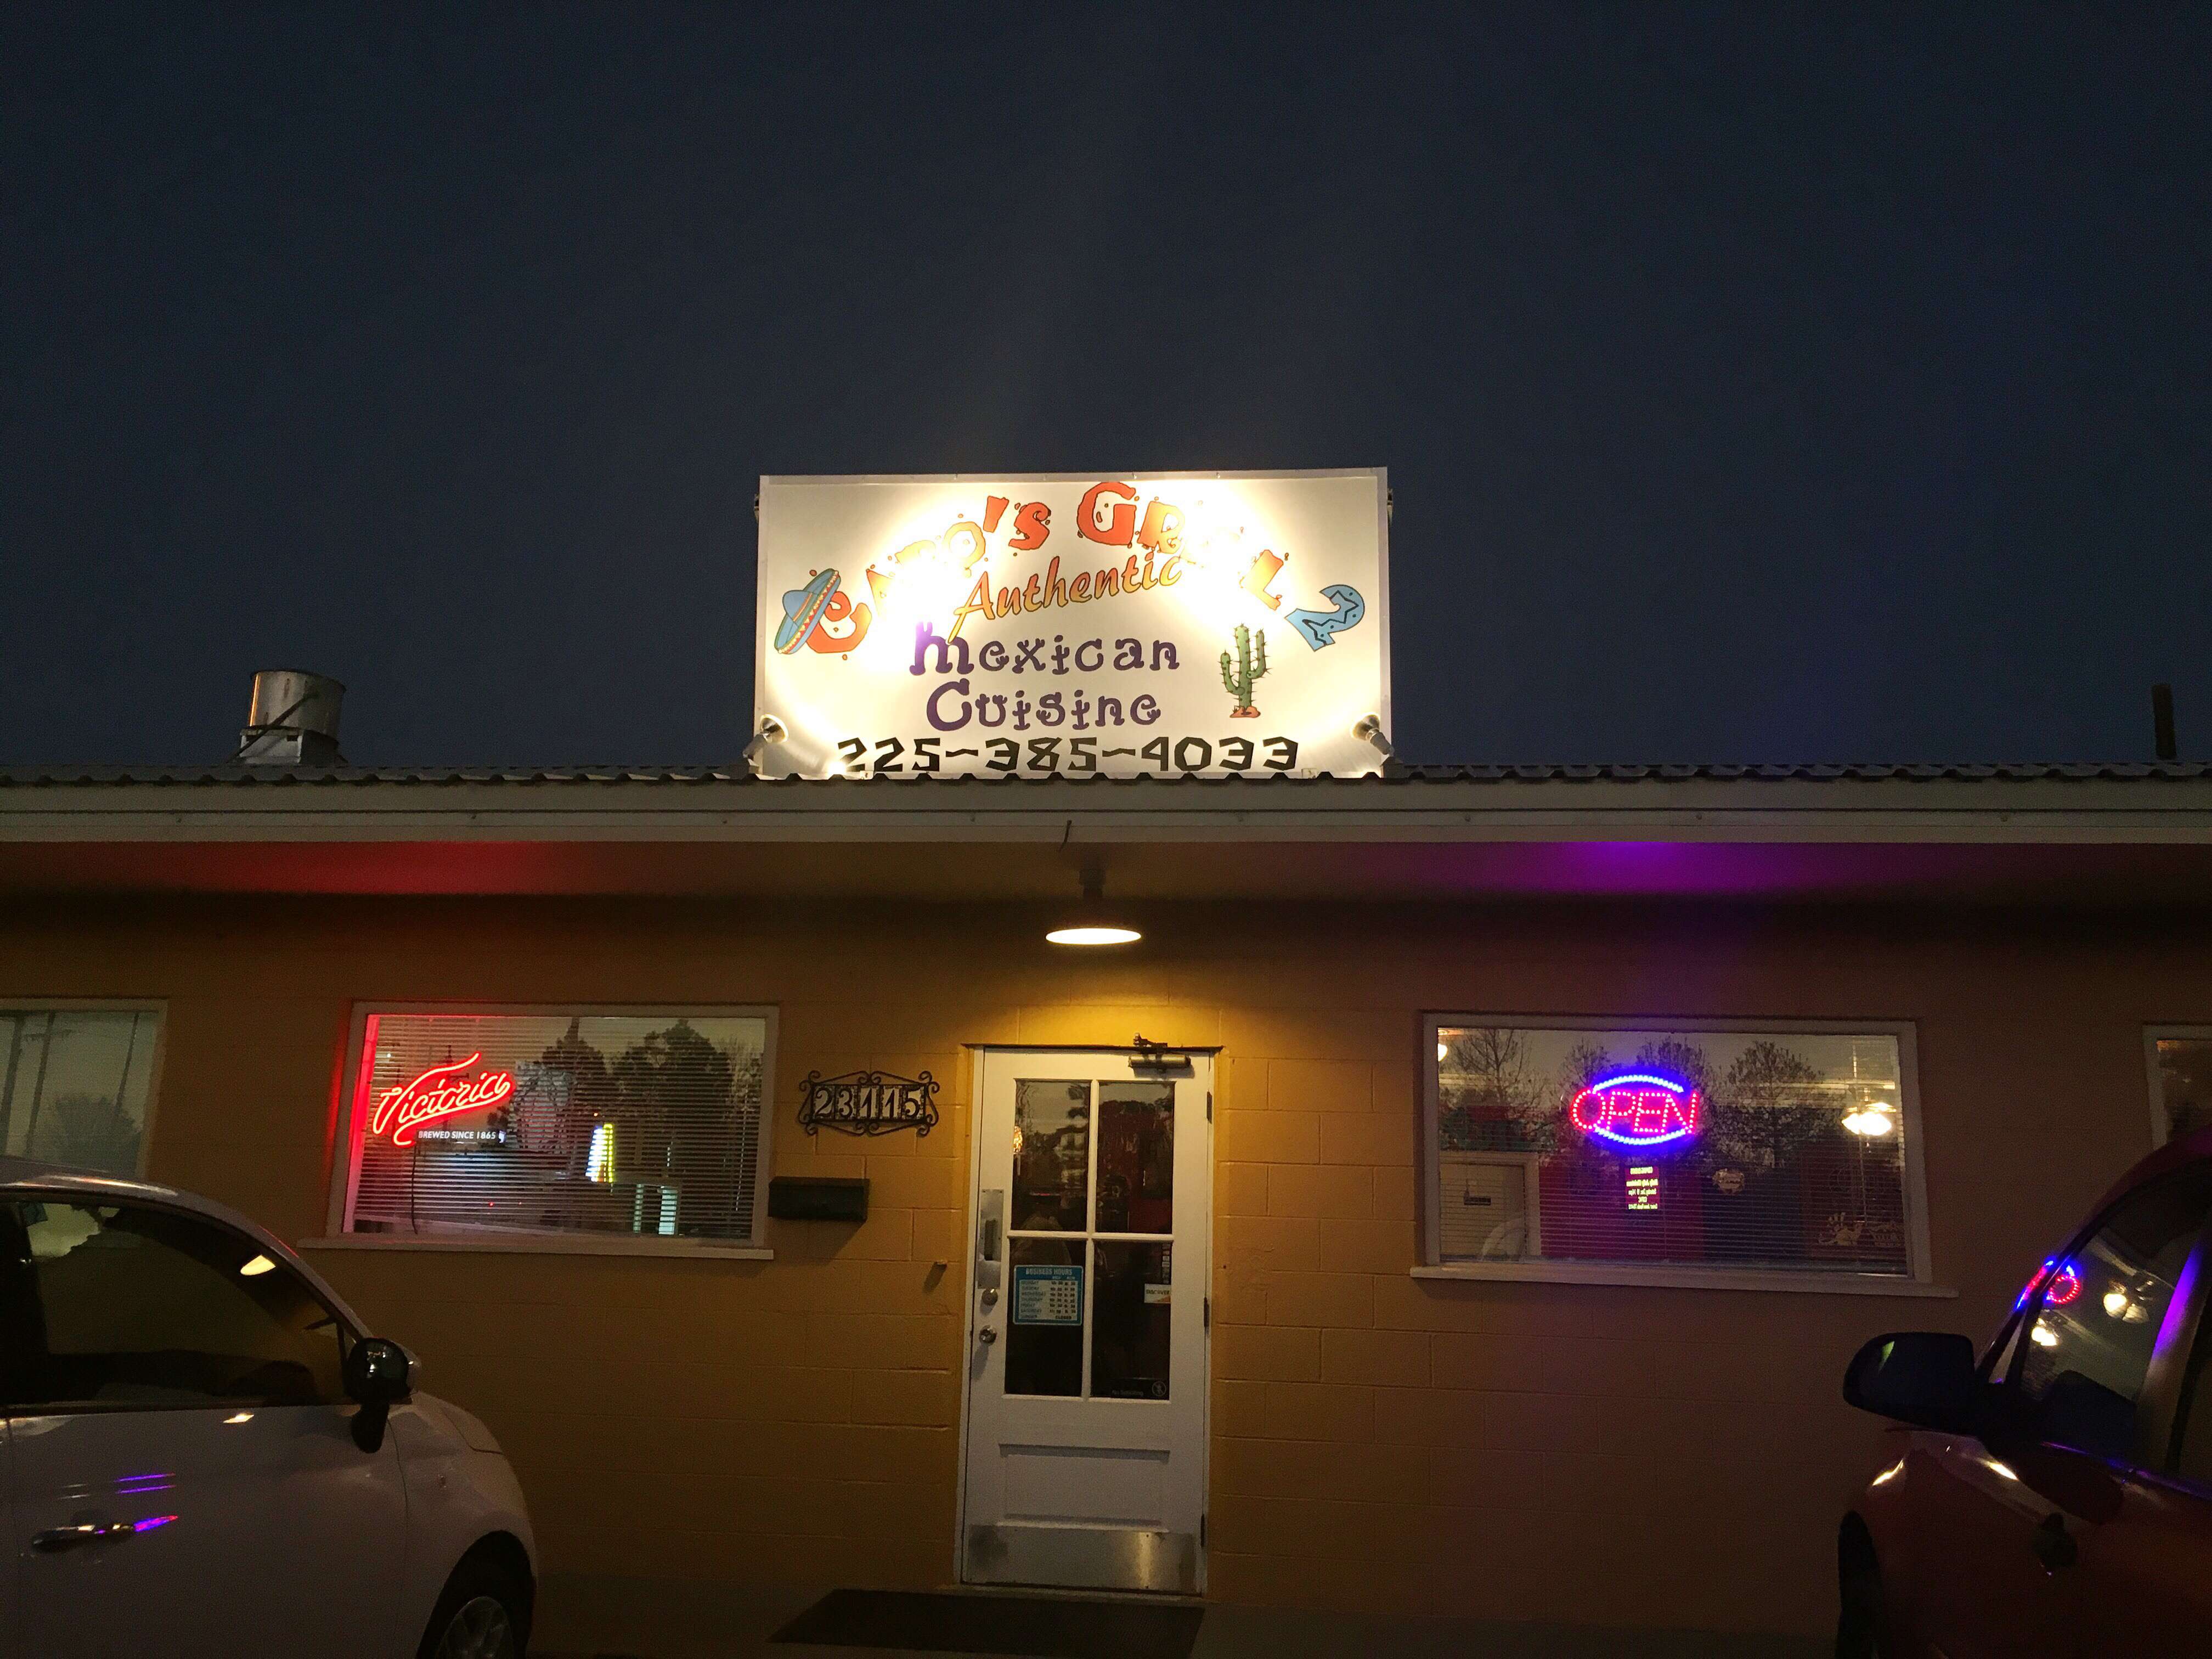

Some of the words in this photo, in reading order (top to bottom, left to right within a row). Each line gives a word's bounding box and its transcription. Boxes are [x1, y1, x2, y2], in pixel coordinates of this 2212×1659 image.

[805, 495, 1051, 654] CO'S
[1076, 482, 1285, 611] GRL
[948, 551, 1182, 644] Authentic
[909, 622, 1180, 676] Mexican
[926, 678, 1162, 732] Cuisine
[373, 1052, 511, 1146] Victoria
[814, 1086, 921, 1118] 23115
[1572, 1089, 1700, 1134] OPEN
[419, 1130, 450, 1139] BREWED
[452, 1131, 473, 1139] SINCE
[476, 1131, 496, 1139] 1865
